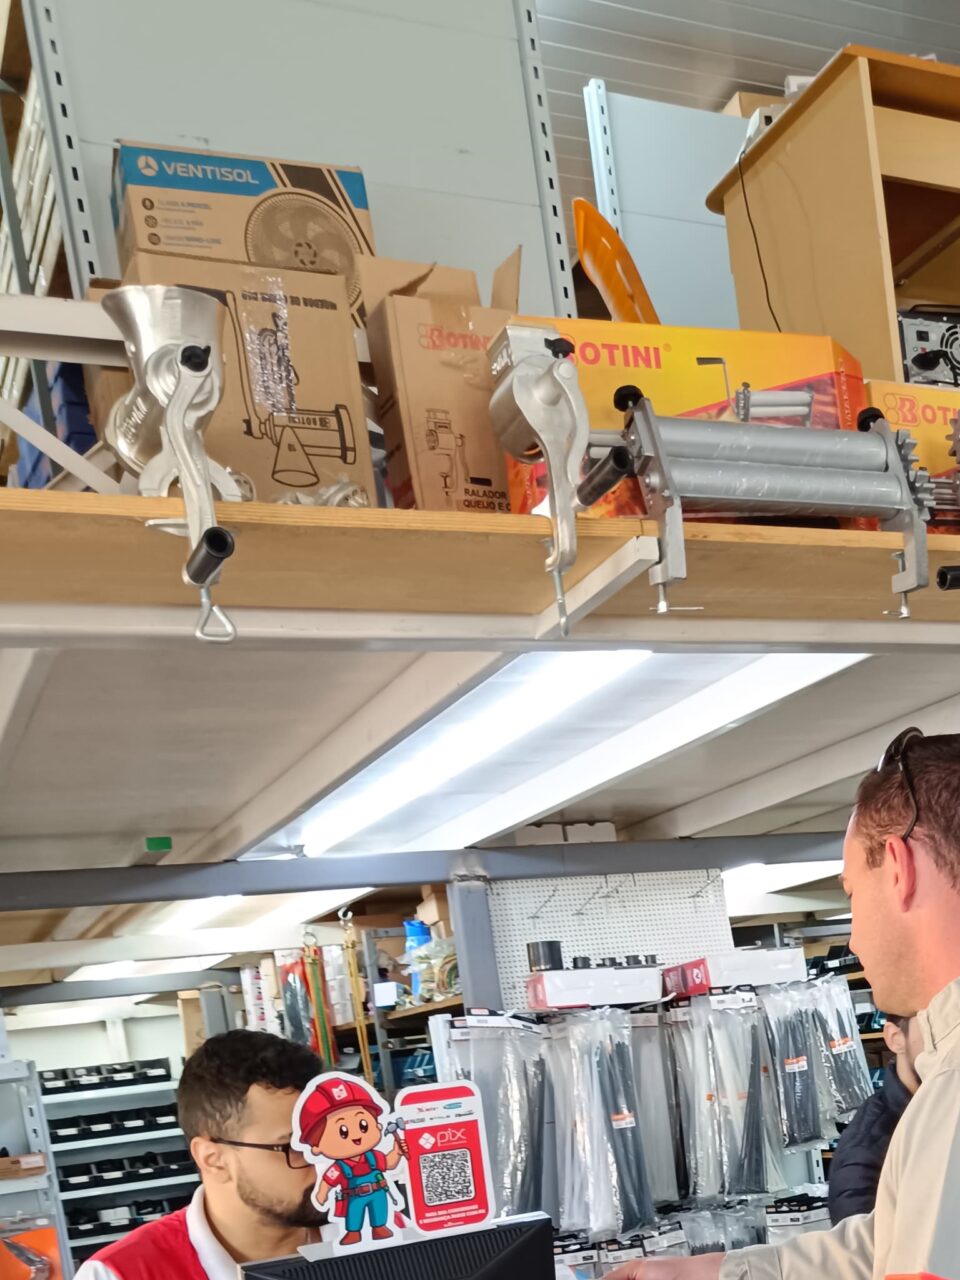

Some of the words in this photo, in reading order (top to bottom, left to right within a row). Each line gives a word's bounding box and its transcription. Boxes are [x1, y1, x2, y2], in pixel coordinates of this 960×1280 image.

[161, 160, 260, 184] VENTISOL
[427, 327, 494, 351] BOTIN
[897, 397, 959, 427] BOTI
[463, 499, 496, 511] QUEIJO
[498, 503, 505, 511] E
[464, 487, 507, 499] RALADOR
